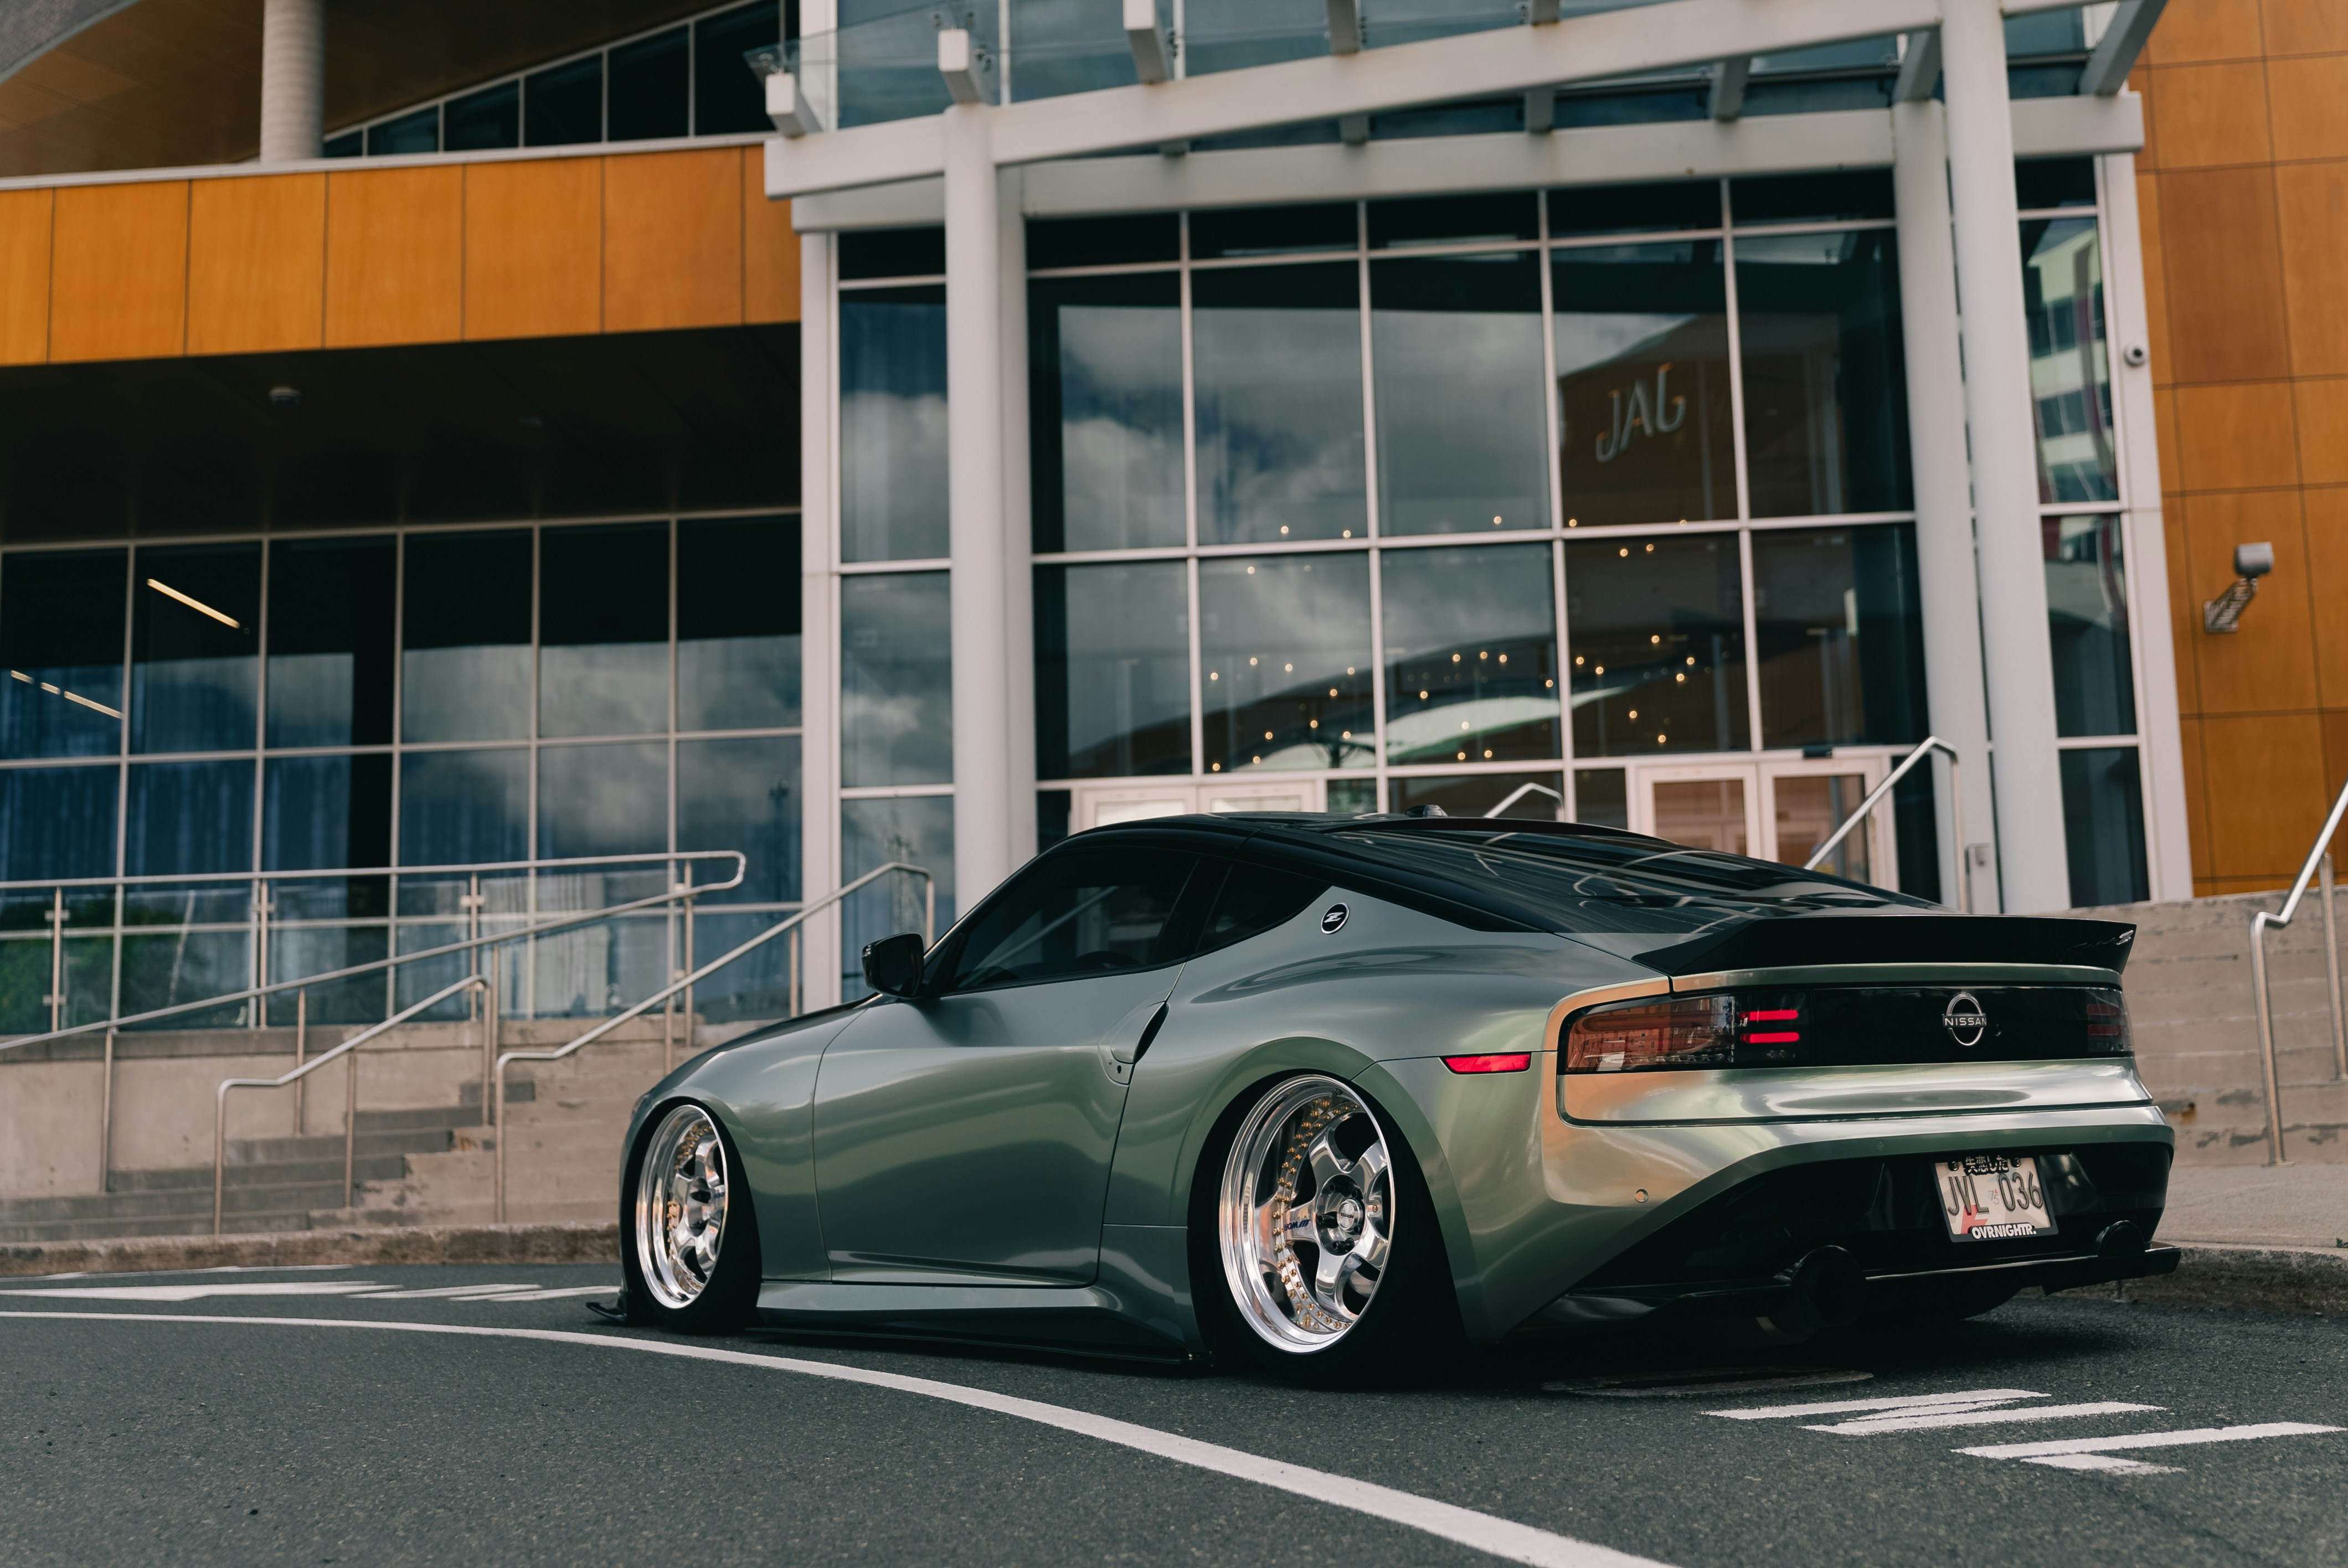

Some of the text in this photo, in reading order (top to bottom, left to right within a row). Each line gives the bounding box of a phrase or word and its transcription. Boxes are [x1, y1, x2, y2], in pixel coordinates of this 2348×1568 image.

[1944, 1017, 1987, 1026] NISSAN
[1965, 1155, 2009, 1173] 失恋した
[1947, 1171, 2043, 1216] JVL 036
